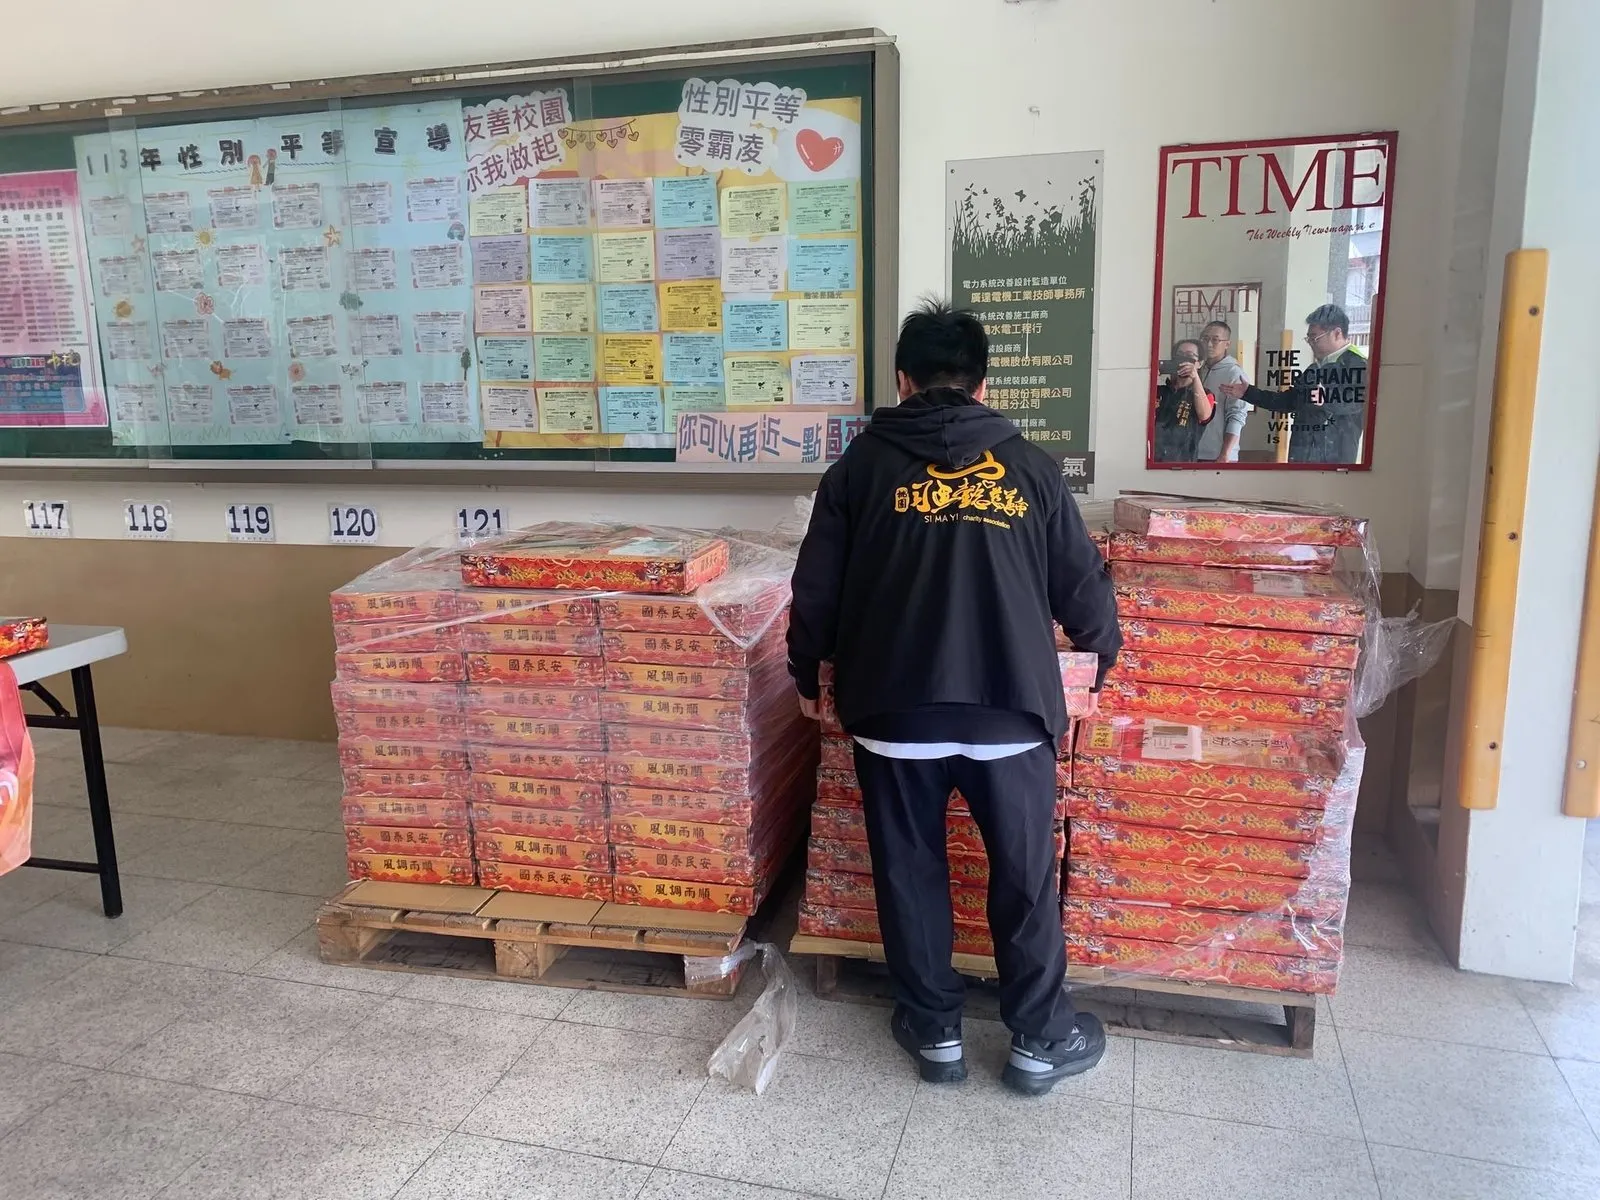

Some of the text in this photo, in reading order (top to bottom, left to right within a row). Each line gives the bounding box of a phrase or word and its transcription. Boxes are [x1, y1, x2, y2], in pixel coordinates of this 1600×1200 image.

[684, 82, 802, 125] 性別平等
[464, 95, 566, 144] 友善校園
[679, 125, 765, 165] 零霸凌
[1172, 145, 1387, 219] TIME
[1247, 228, 1264, 241] The
[1266, 227, 1302, 240] Weekly
[966, 310, 1048, 322] 力系統改善施工廠商
[987, 354, 1073, 368] 電機股份有限公司
[1266, 350, 1300, 367] THE
[1266, 367, 1366, 387] MERCHANT
[1268, 421, 1328, 432] Winner
[679, 413, 822, 463] 你可以再近一點
[1267, 434, 1280, 444] Is
[1062, 457, 1086, 477] 氣
[28, 503, 65, 530] 117
[128, 504, 168, 533] 118
[228, 505, 271, 534] 119
[332, 508, 376, 537] 120
[459, 508, 501, 537] 121
[934, 515, 949, 523] MA
[641, 605, 698, 620] 國泰民安
[644, 637, 701, 652] 國泰民安
[508, 658, 562, 672] 國泰民安
[646, 669, 702, 684] 風調雨順
[643, 700, 699, 715] 風調雨順
[647, 762, 703, 777] 風調雨順
[509, 781, 561, 796] 風調雨順
[380, 830, 429, 843] 國泰民安
[650, 822, 705, 840] 風調雨順
[514, 840, 568, 856] 風調雨順
[383, 859, 434, 872] 風調雨順
[656, 853, 712, 870] 國泰民安
[519, 869, 572, 885] 國泰民安
[655, 883, 711, 899] 風調雨順
